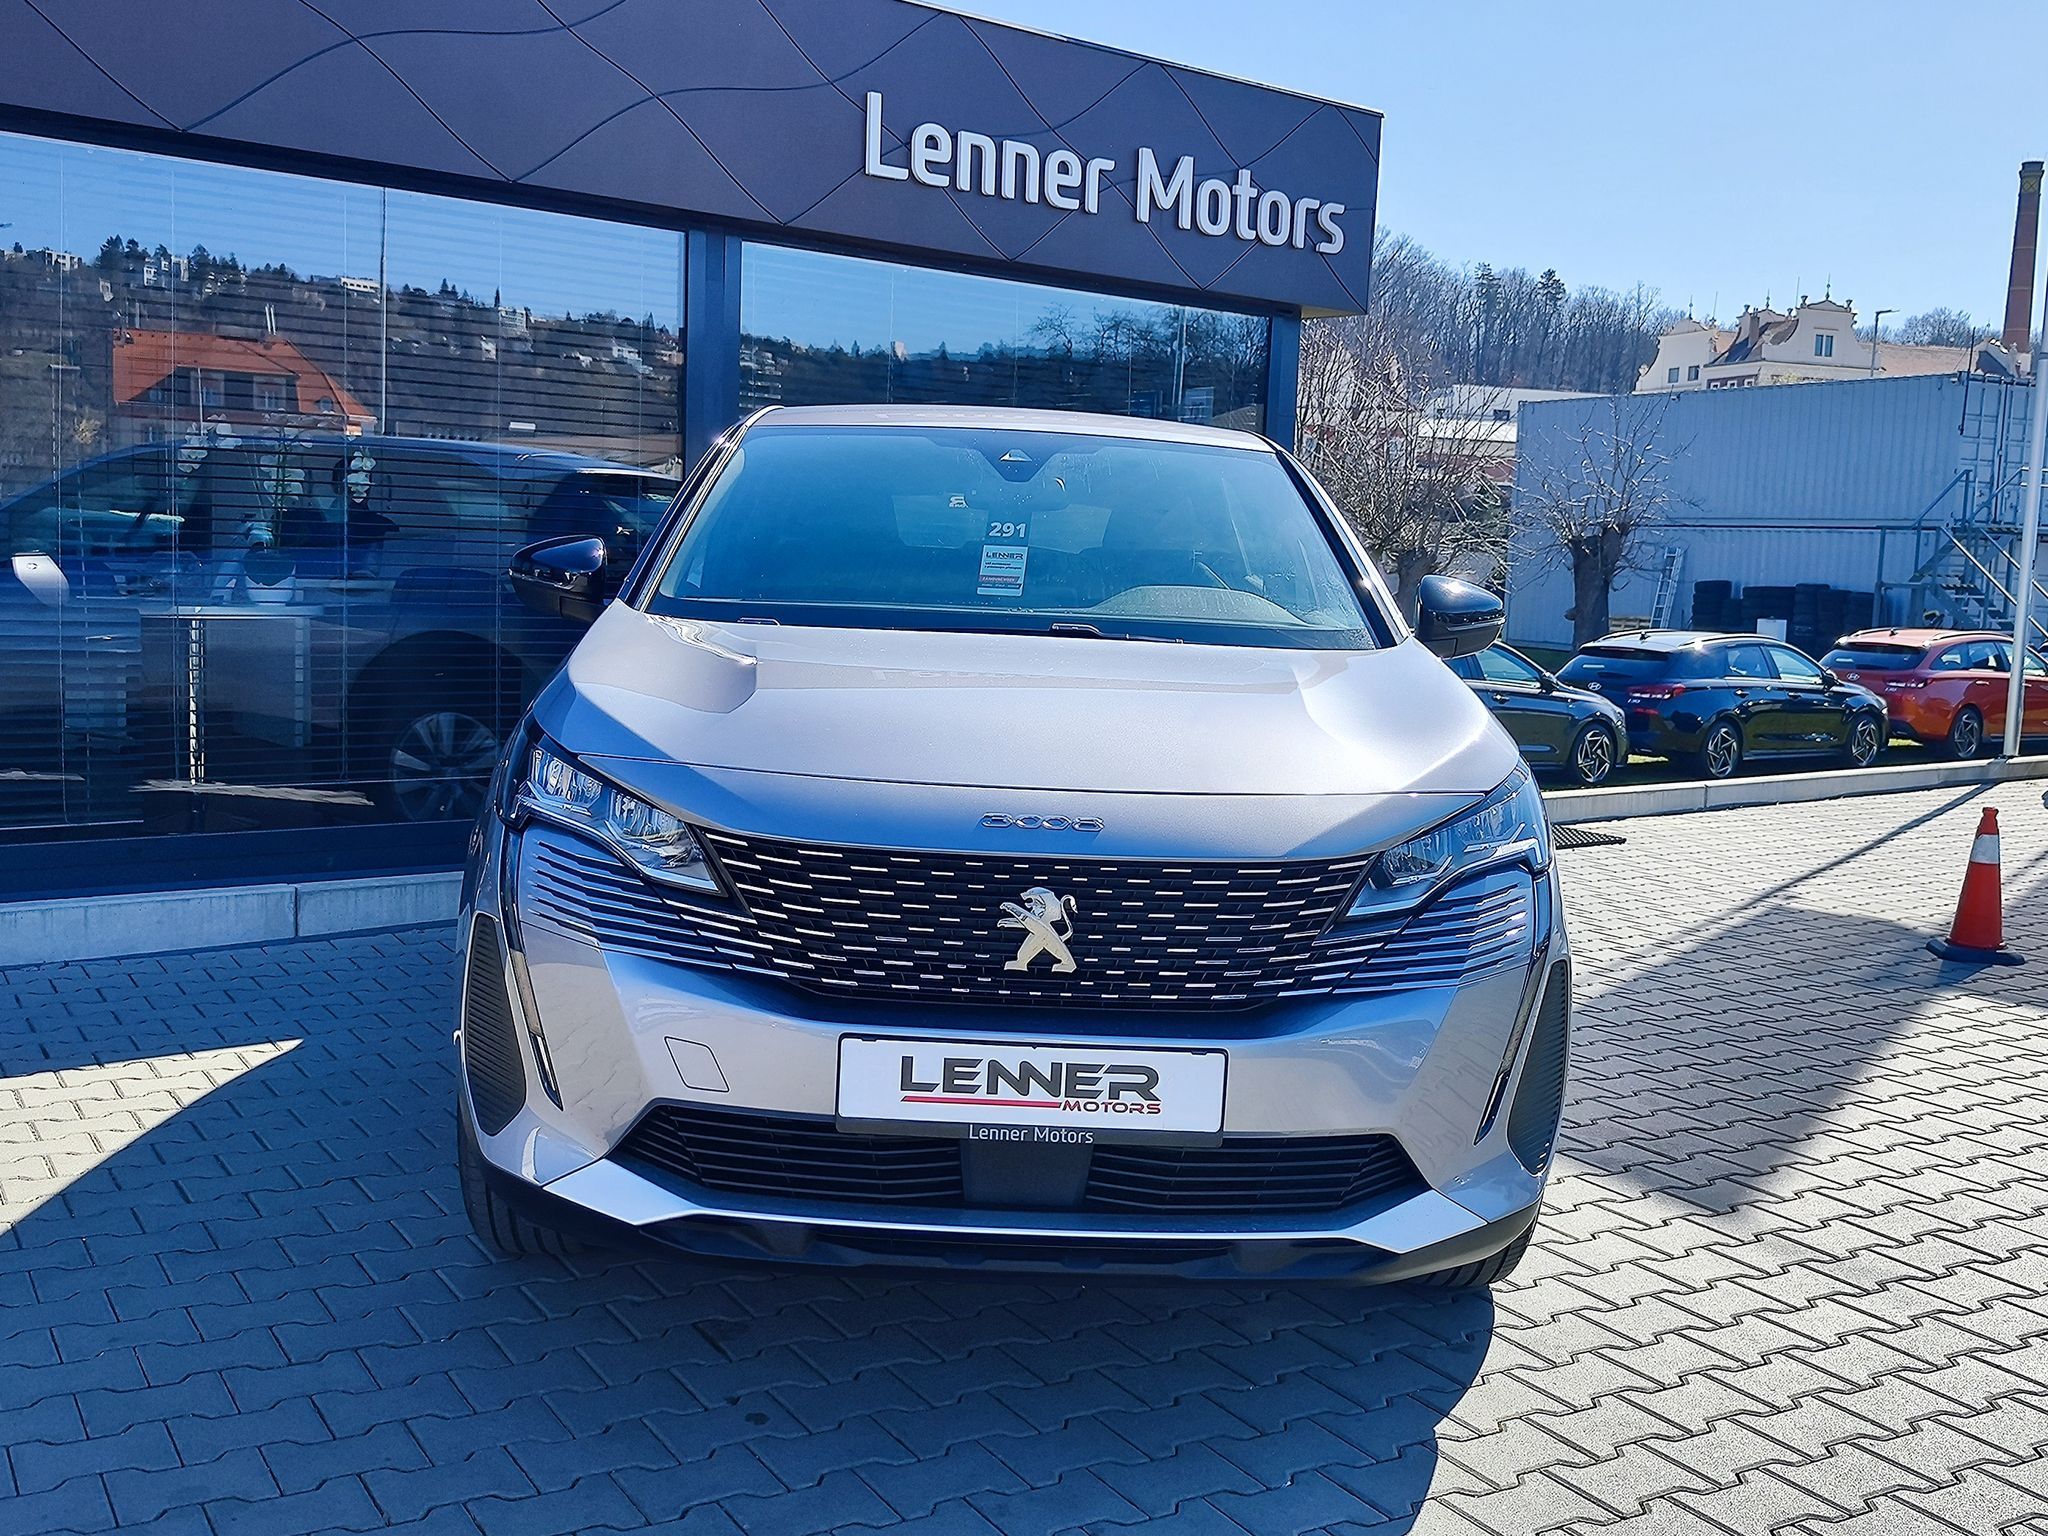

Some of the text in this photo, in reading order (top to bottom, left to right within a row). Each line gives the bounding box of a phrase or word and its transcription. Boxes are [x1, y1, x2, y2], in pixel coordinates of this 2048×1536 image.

[864, 91, 1345, 255] Lenner Motors
[988, 521, 1027, 538] 291
[985, 551, 1024, 560] LENNER
[900, 1055, 1162, 1102] LENNER
[1060, 1099, 1162, 1115] MOTORS
[968, 1124, 1094, 1145] Lenner Motors
